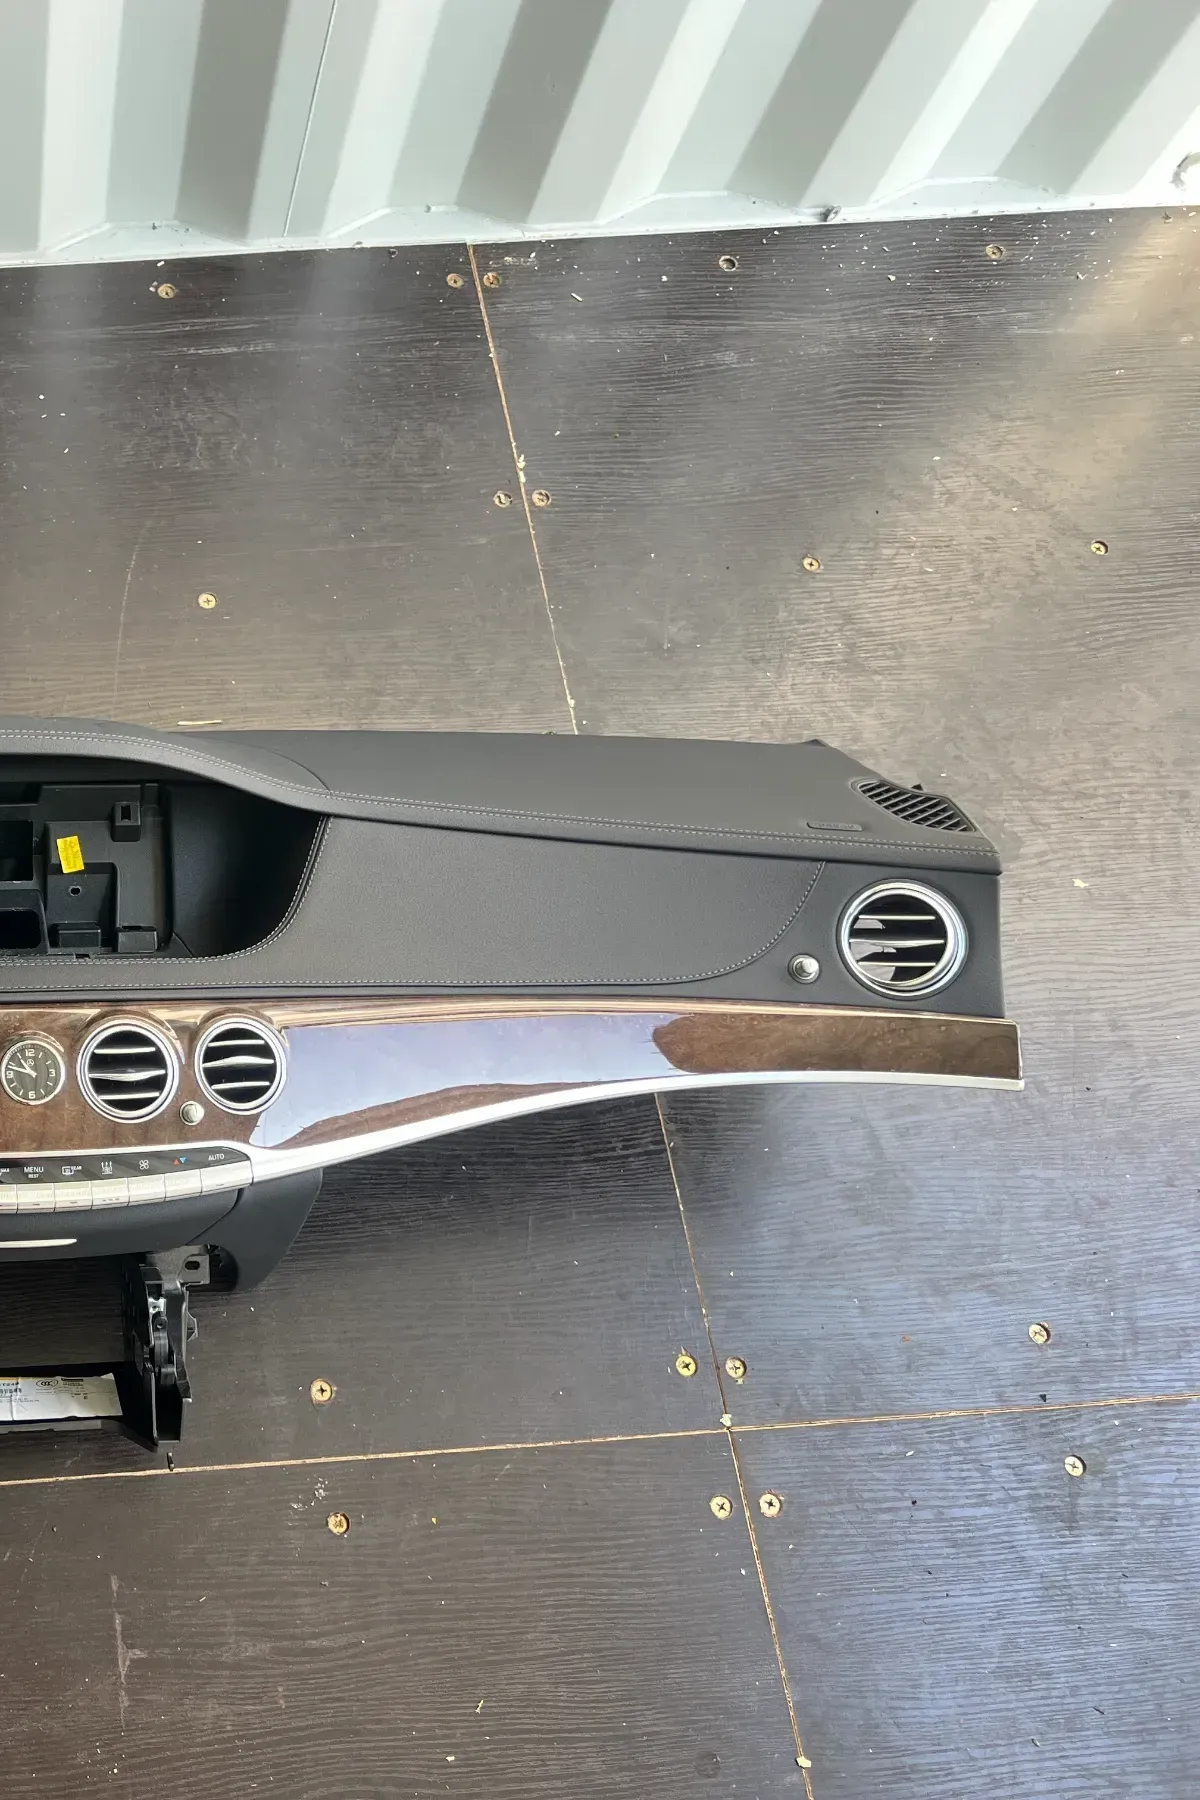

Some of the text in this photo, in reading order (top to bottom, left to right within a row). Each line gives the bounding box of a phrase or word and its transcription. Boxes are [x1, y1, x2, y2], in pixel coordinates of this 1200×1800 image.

[25, 1048, 36, 1057] 12
[6, 1070, 14, 1079] 9
[48, 1069, 56, 1077] 3
[28, 1091, 36, 1099] 6
[207, 1153, 225, 1161] AUTO
